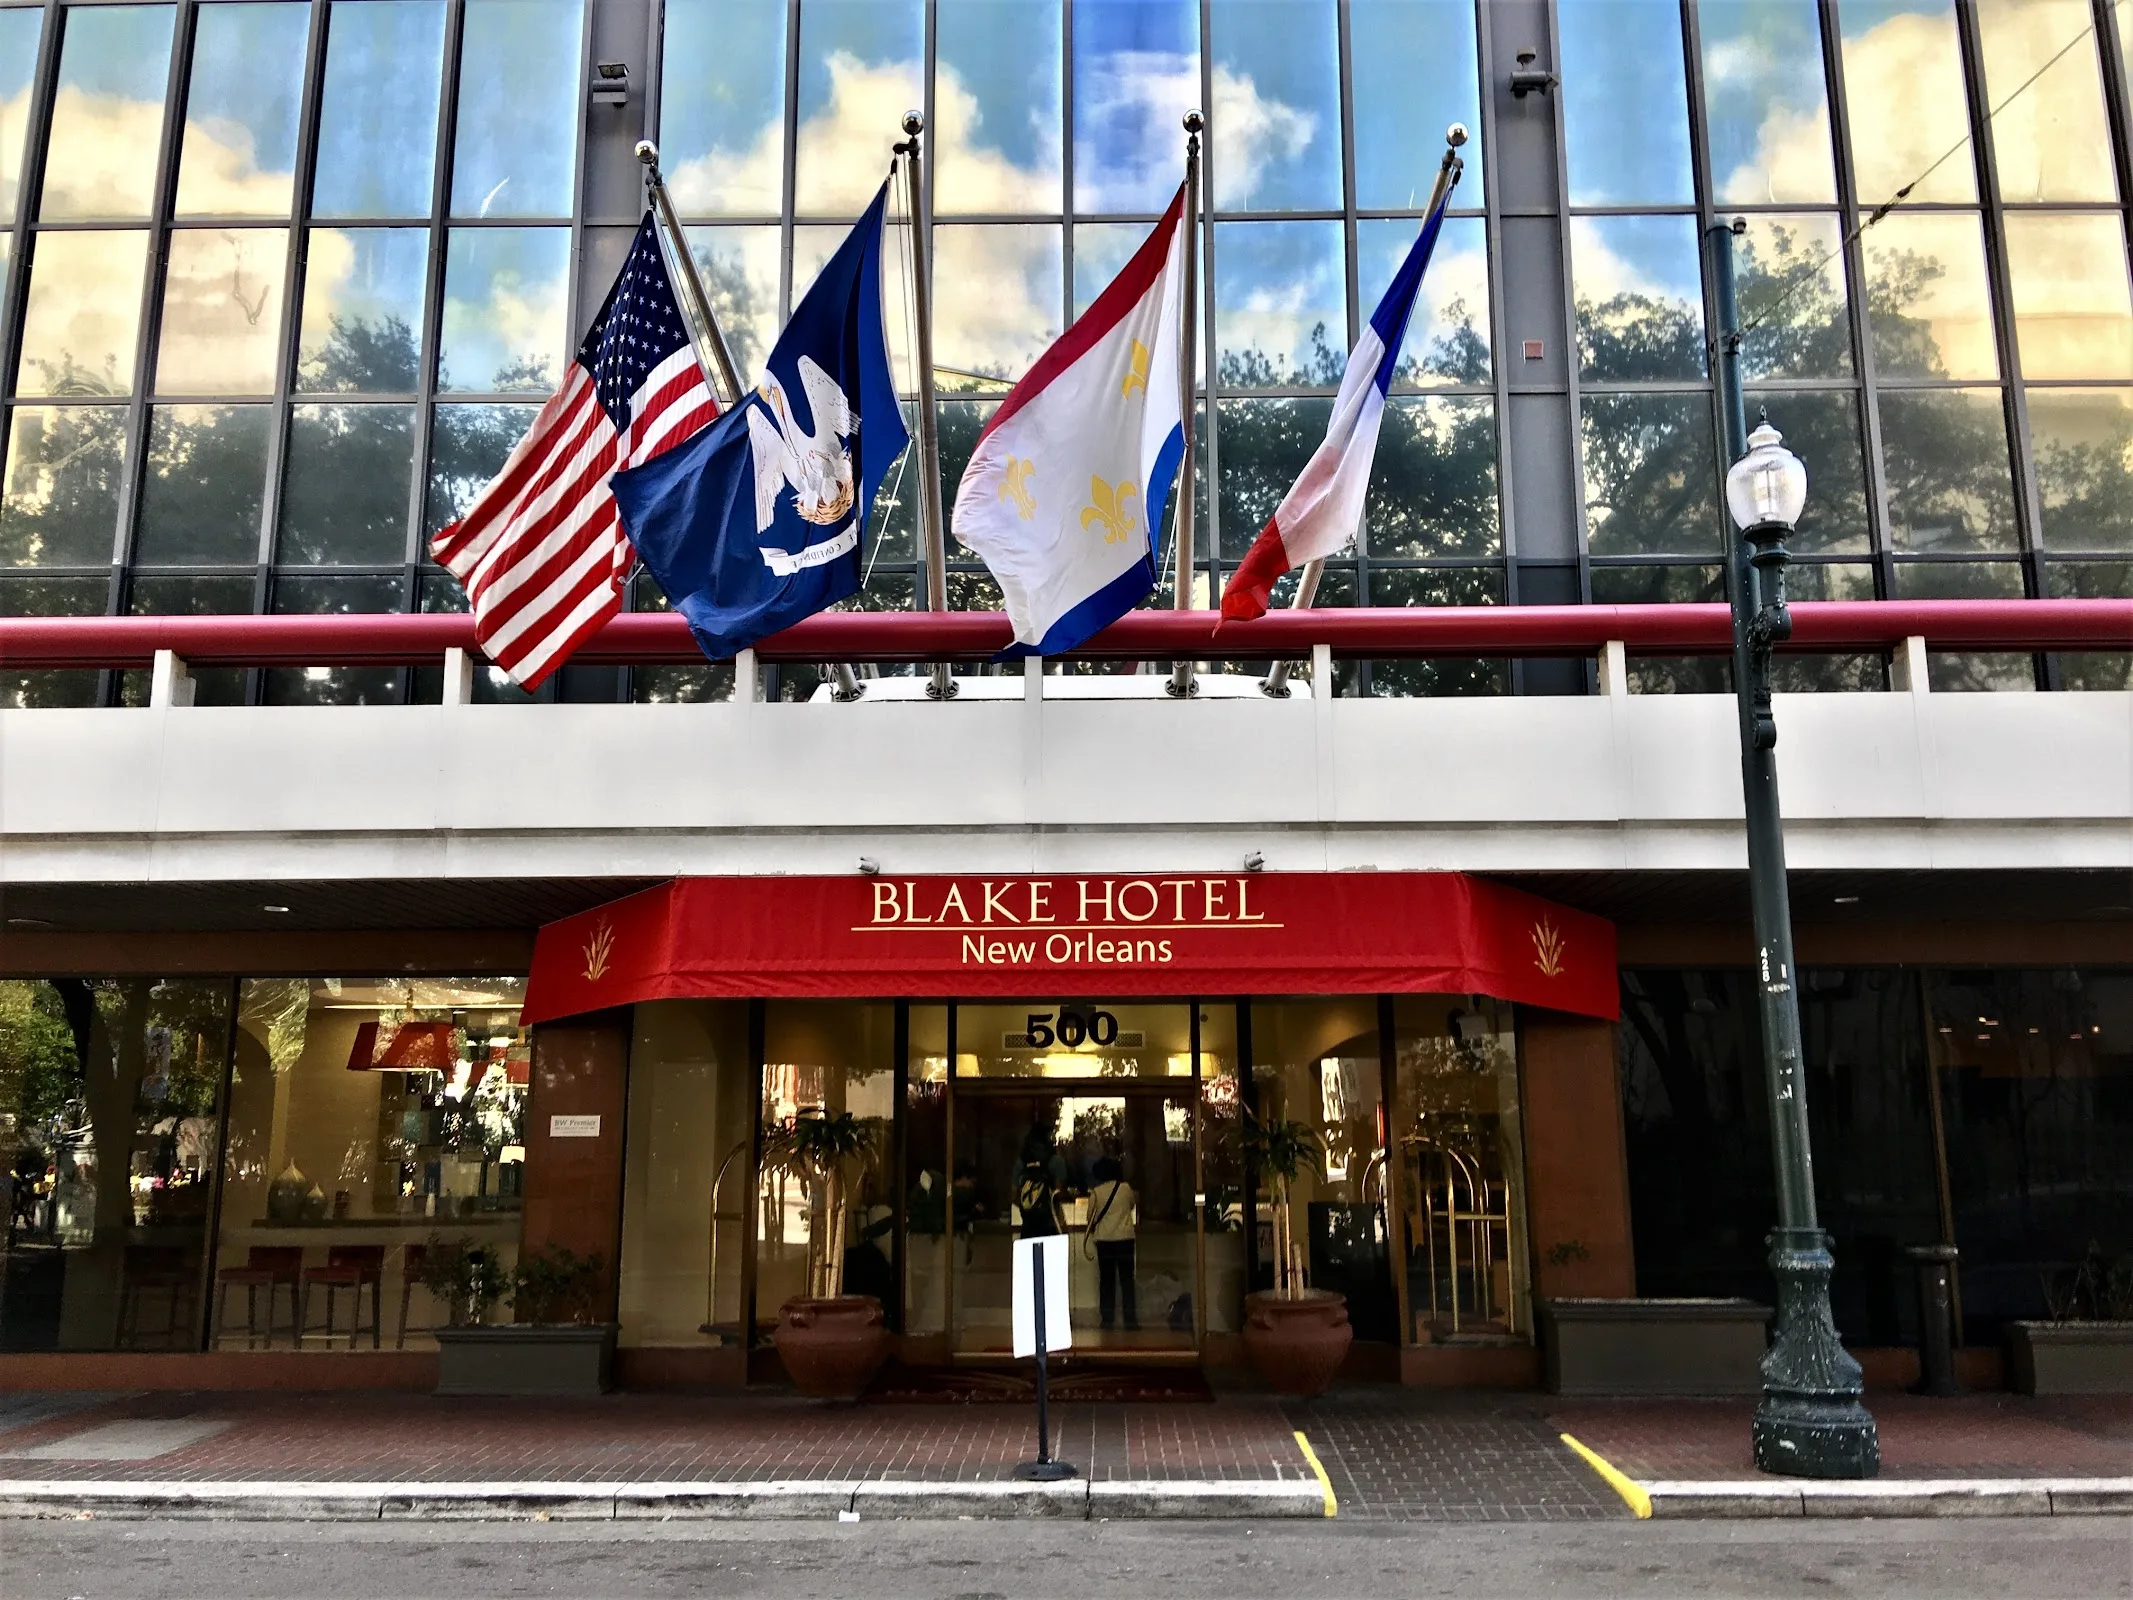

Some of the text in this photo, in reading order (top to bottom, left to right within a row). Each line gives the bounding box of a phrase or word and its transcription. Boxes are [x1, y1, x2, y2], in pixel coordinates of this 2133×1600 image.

[870, 879, 1265, 924] BLAKE HOTEL
[962, 932, 1173, 964] New Orleans
[1760, 946, 1771, 982] 428
[1025, 1011, 1119, 1049] 500
[569, 1119, 597, 1127] Premier
